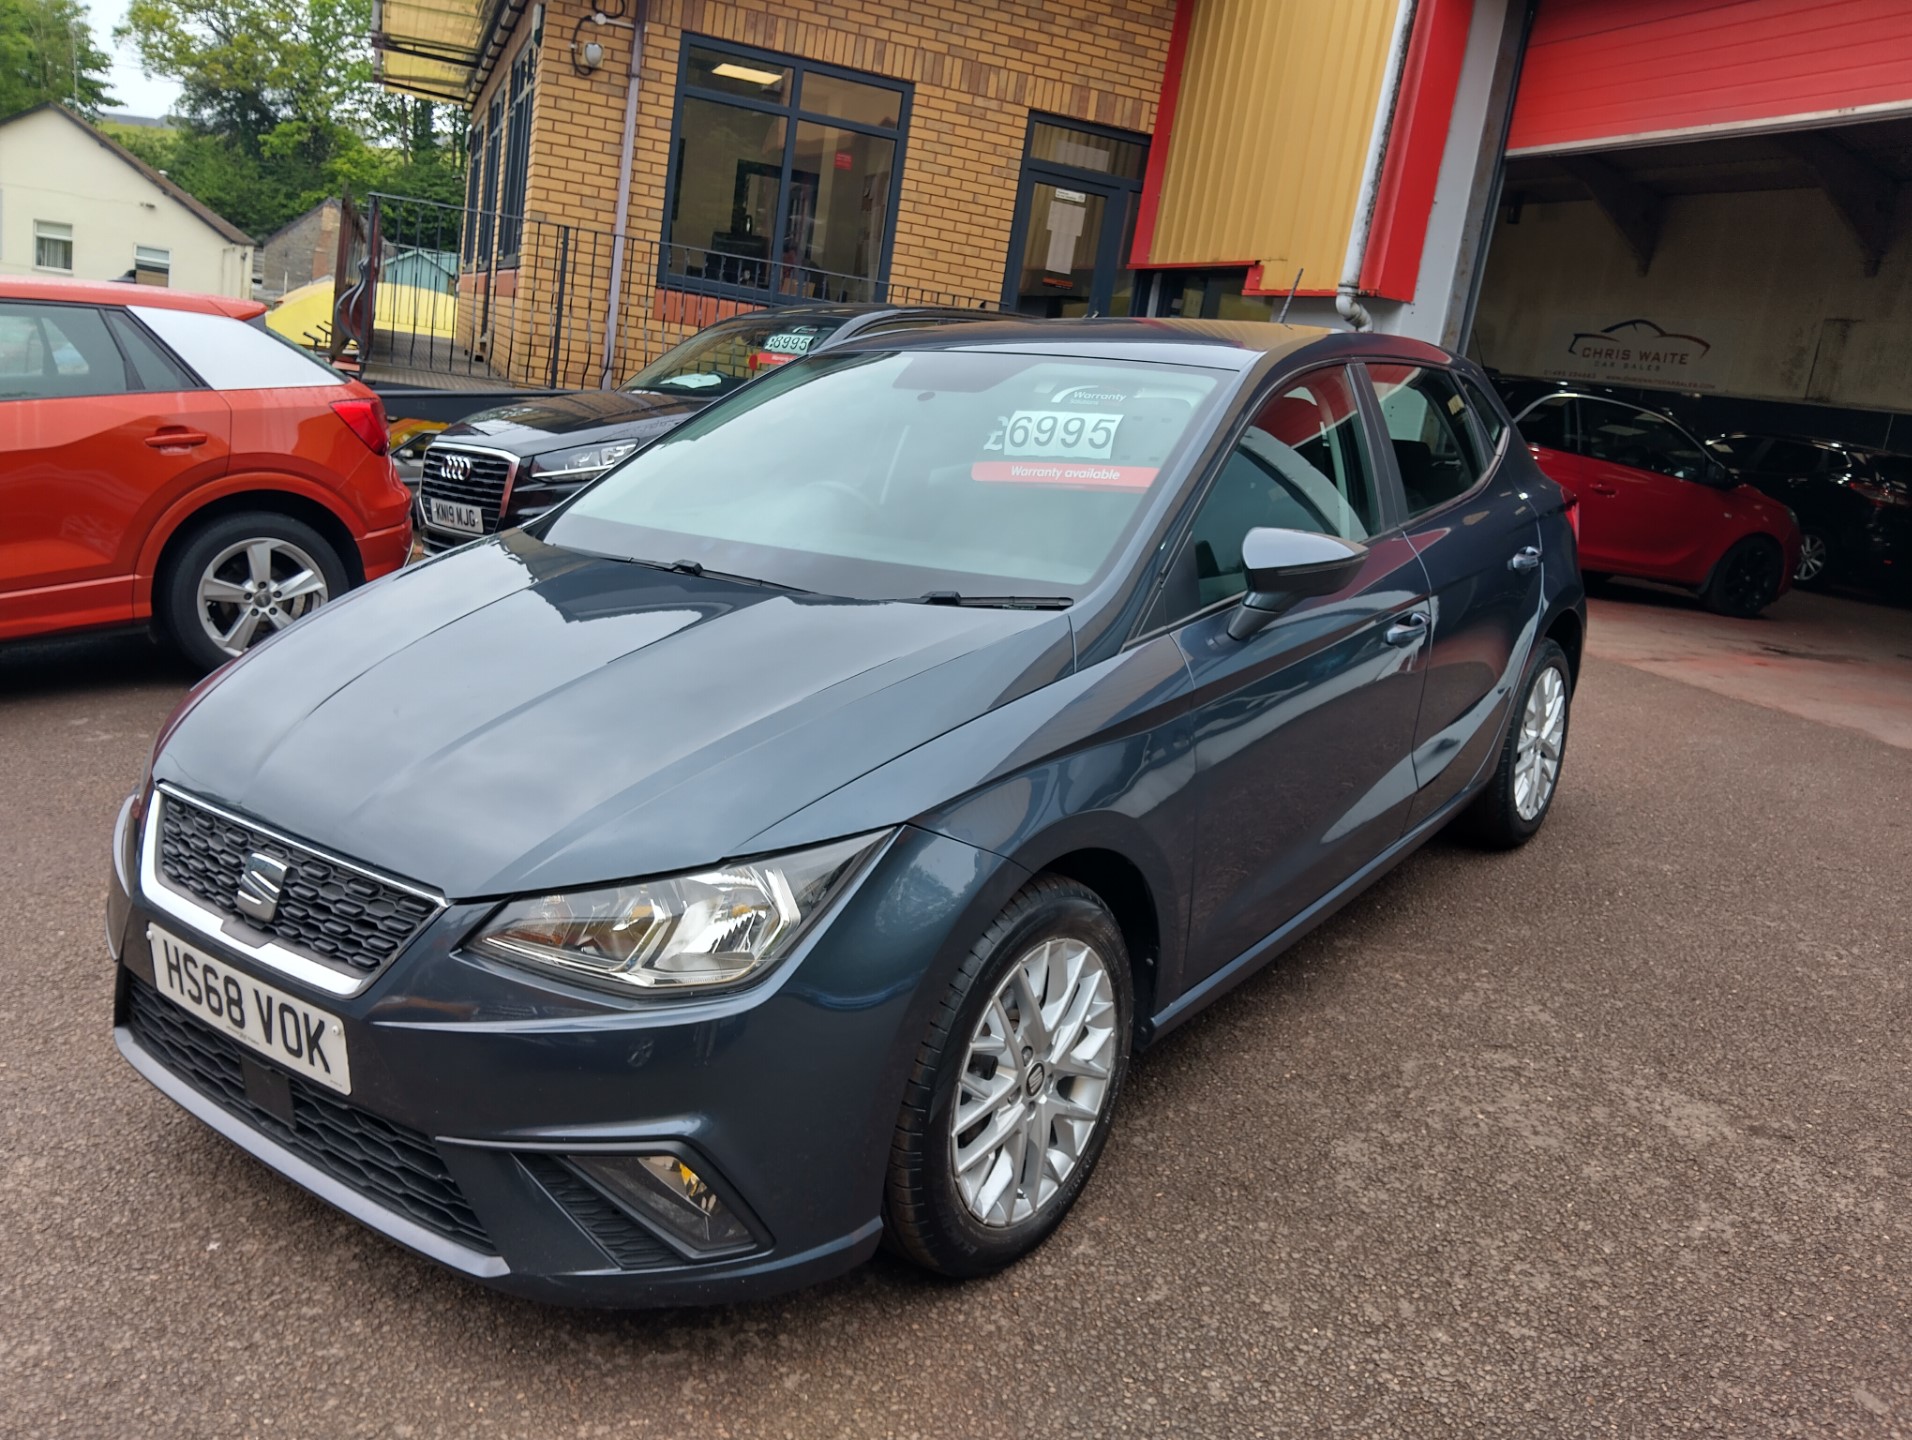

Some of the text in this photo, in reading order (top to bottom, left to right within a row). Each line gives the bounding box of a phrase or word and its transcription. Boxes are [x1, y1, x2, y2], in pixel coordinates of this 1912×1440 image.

[1582, 347, 1690, 365] CHRIS WAITE
[1623, 363, 1661, 372] SALES
[1074, 391, 1127, 402] Warranty
[1011, 465, 1121, 481] Warranty available
[435, 502, 476, 526] KN19 MJG
[162, 938, 332, 1075] HS68 VOK
